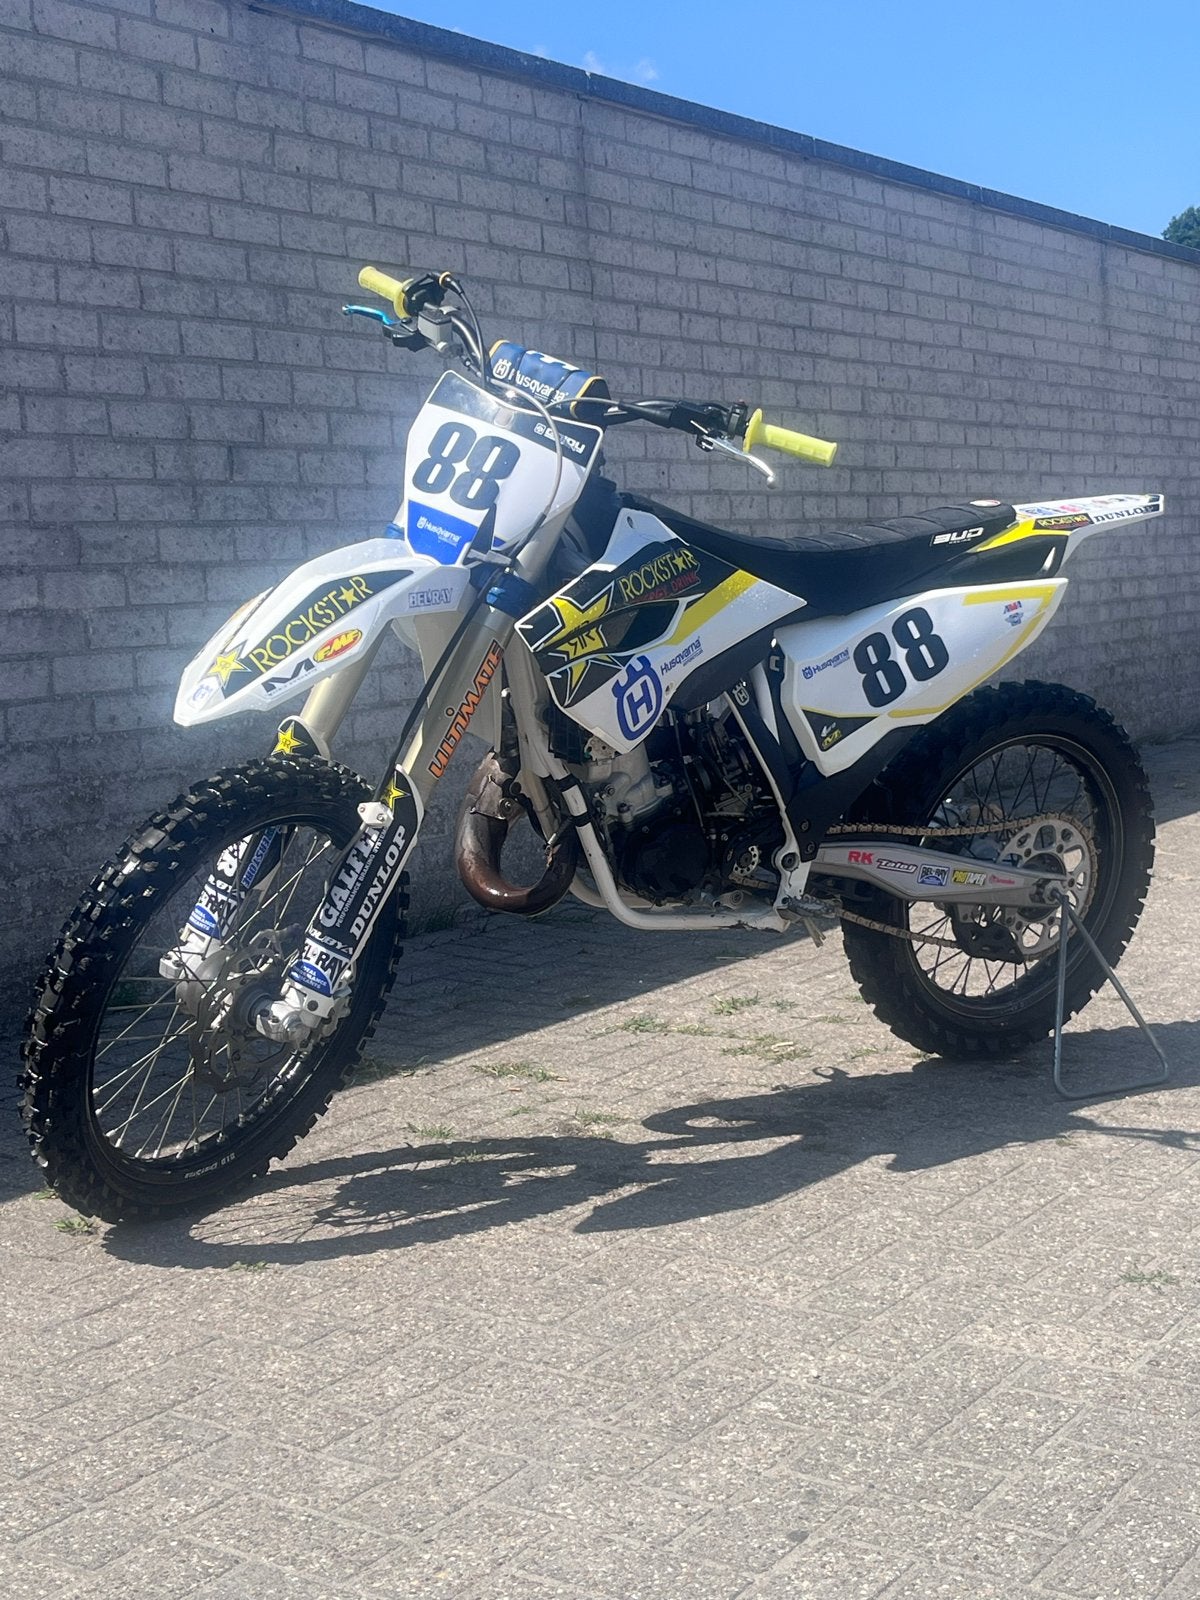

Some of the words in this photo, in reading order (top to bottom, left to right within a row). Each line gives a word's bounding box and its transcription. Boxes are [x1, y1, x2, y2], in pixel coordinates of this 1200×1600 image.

[412, 421, 521, 511] 88
[1093, 504, 1155, 523] DUNLOP
[424, 520, 462, 543] Husqvarna
[933, 526, 985, 545] BUD
[618, 547, 698, 602] ROCKSTAR
[249, 575, 374, 675] ROCKSTAR
[316, 629, 361, 662] FMF
[660, 636, 702, 676] Husqvarna
[812, 647, 849, 675] Husqvarna
[852, 606, 949, 708] 88
[358, 853, 375, 881] BRAKING
[848, 850, 874, 865] RK
[349, 825, 406, 941] DUNLOP
